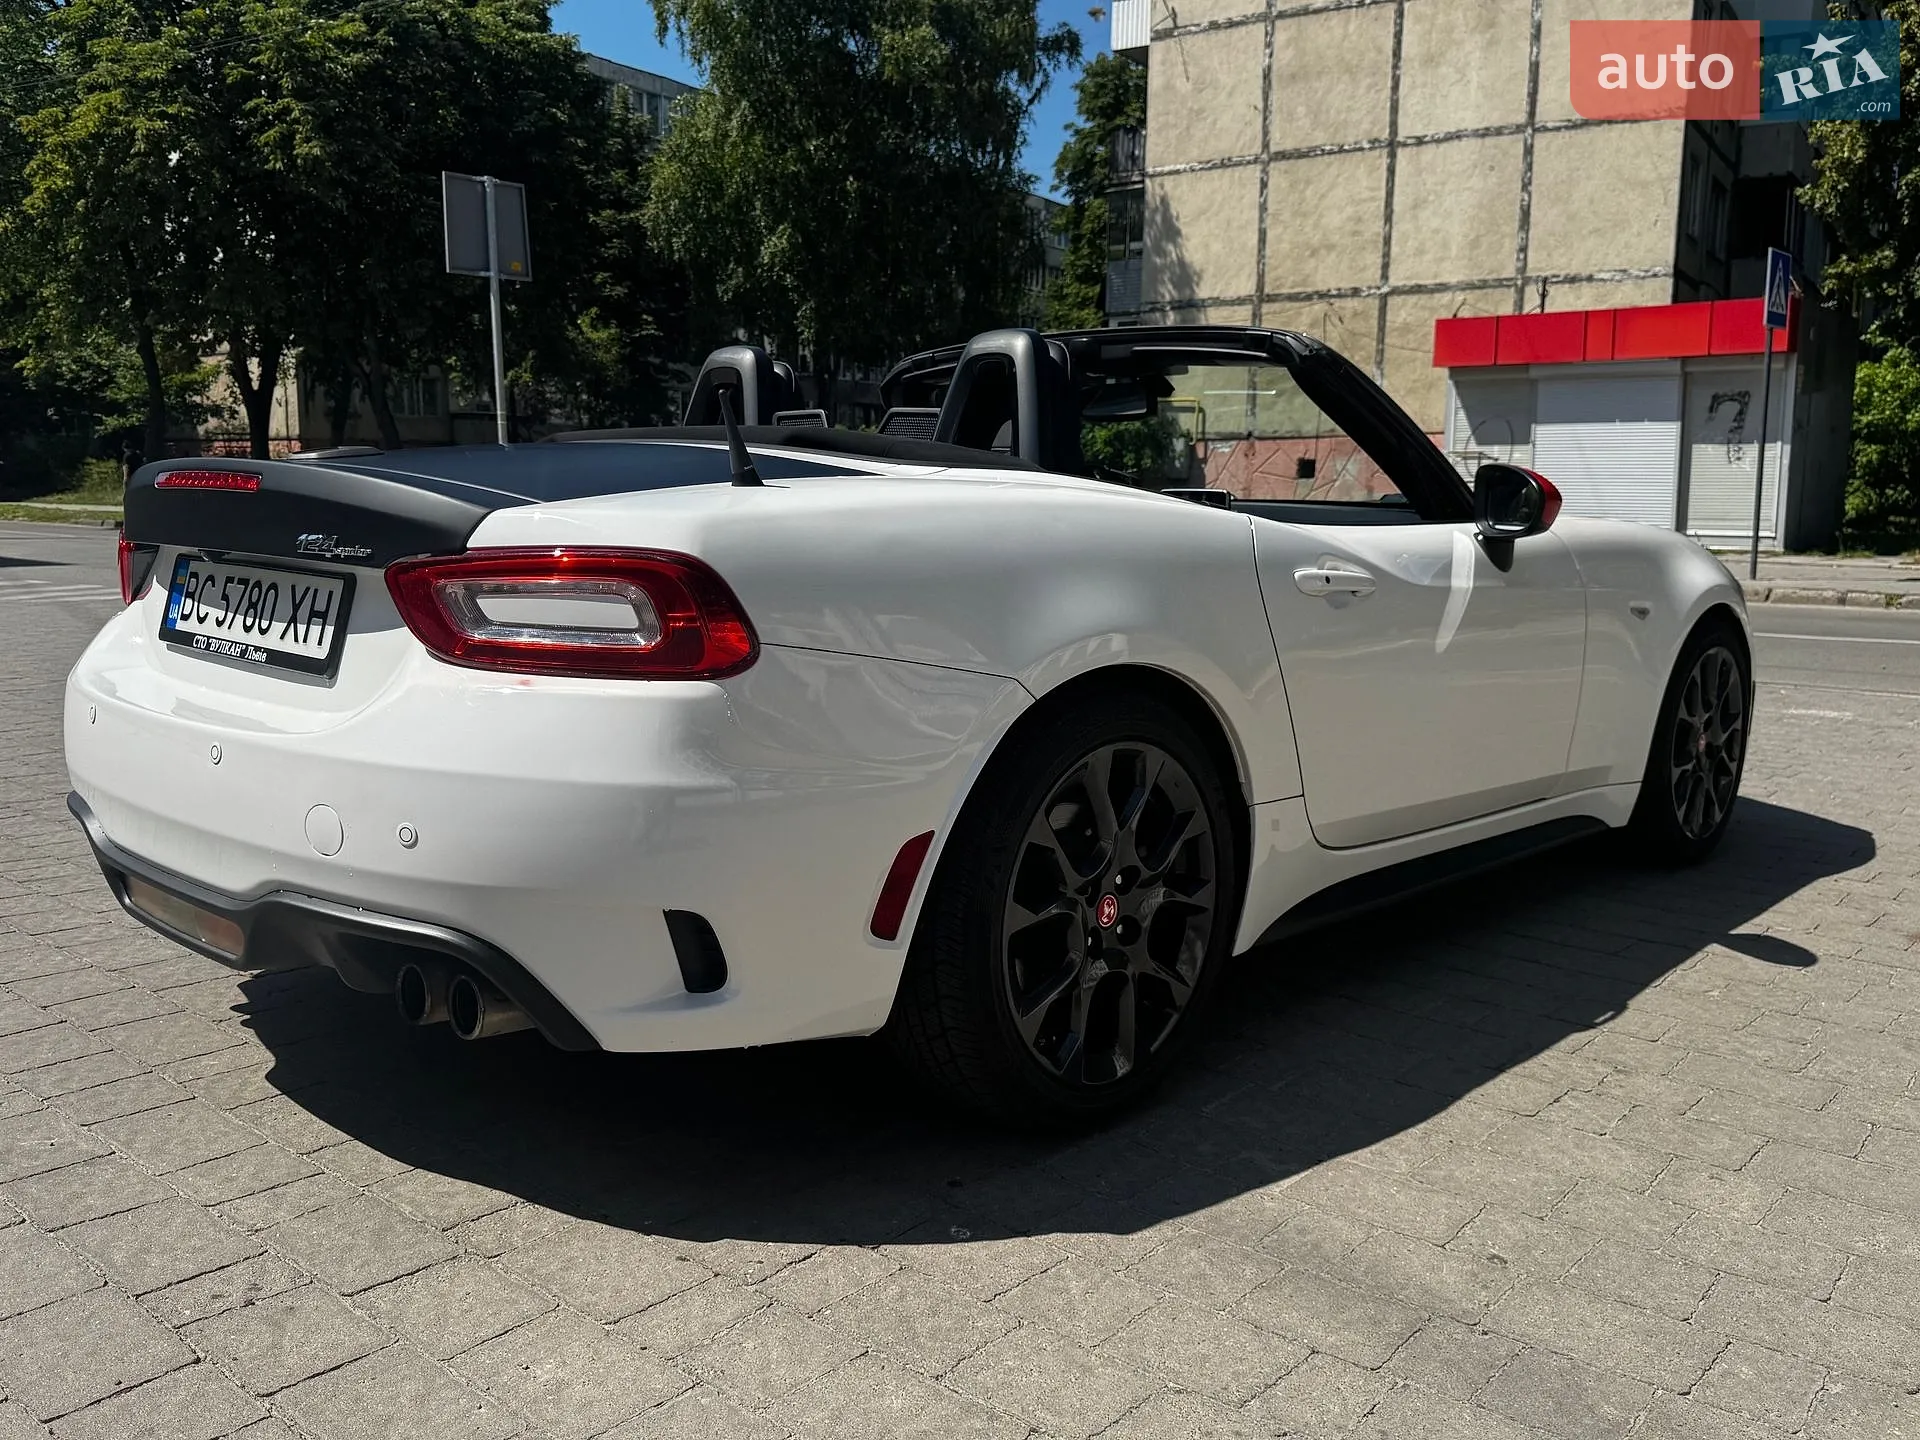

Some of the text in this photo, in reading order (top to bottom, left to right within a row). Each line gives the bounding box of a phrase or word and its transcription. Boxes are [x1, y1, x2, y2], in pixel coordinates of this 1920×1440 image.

[168, 603, 179, 620] UA
[180, 571, 334, 647] BC 5780 XH
[193, 635, 208, 648] СТО
[245, 646, 267, 662] Львів
